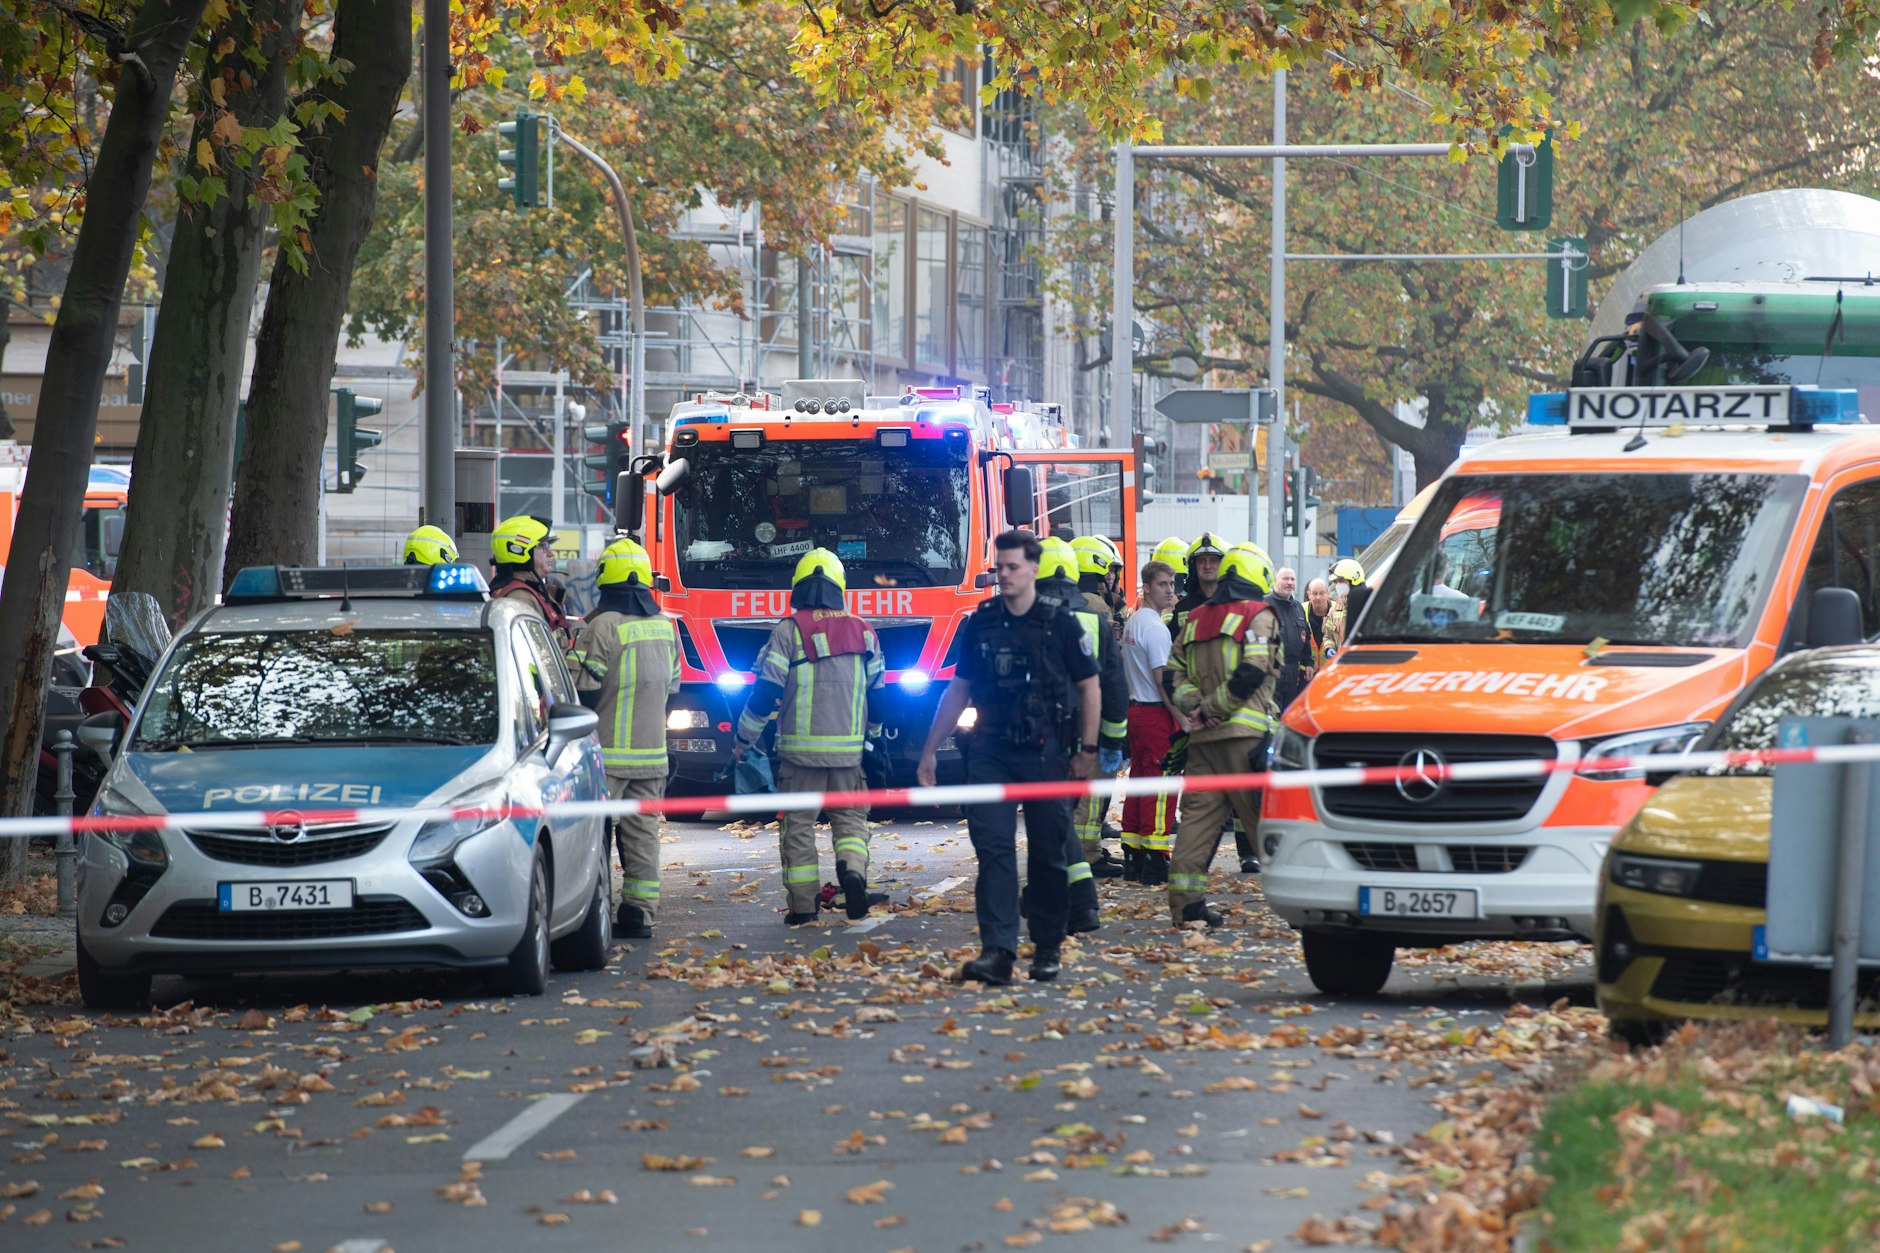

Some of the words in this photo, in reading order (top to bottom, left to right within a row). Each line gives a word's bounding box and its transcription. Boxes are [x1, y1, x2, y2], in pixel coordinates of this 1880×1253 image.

[1577, 391, 1782, 419] NOTARZT
[773, 546, 789, 555] LHF
[789, 542, 810, 552] 4400
[731, 591, 913, 617] FEUEHR
[1326, 671, 1608, 702] FEUERWEHR
[203, 783, 382, 809] POLIZEI
[249, 886, 263, 907] B
[276, 885, 331, 906] 7431
[1384, 891, 1396, 912] B
[1409, 892, 1458, 914] 2657
